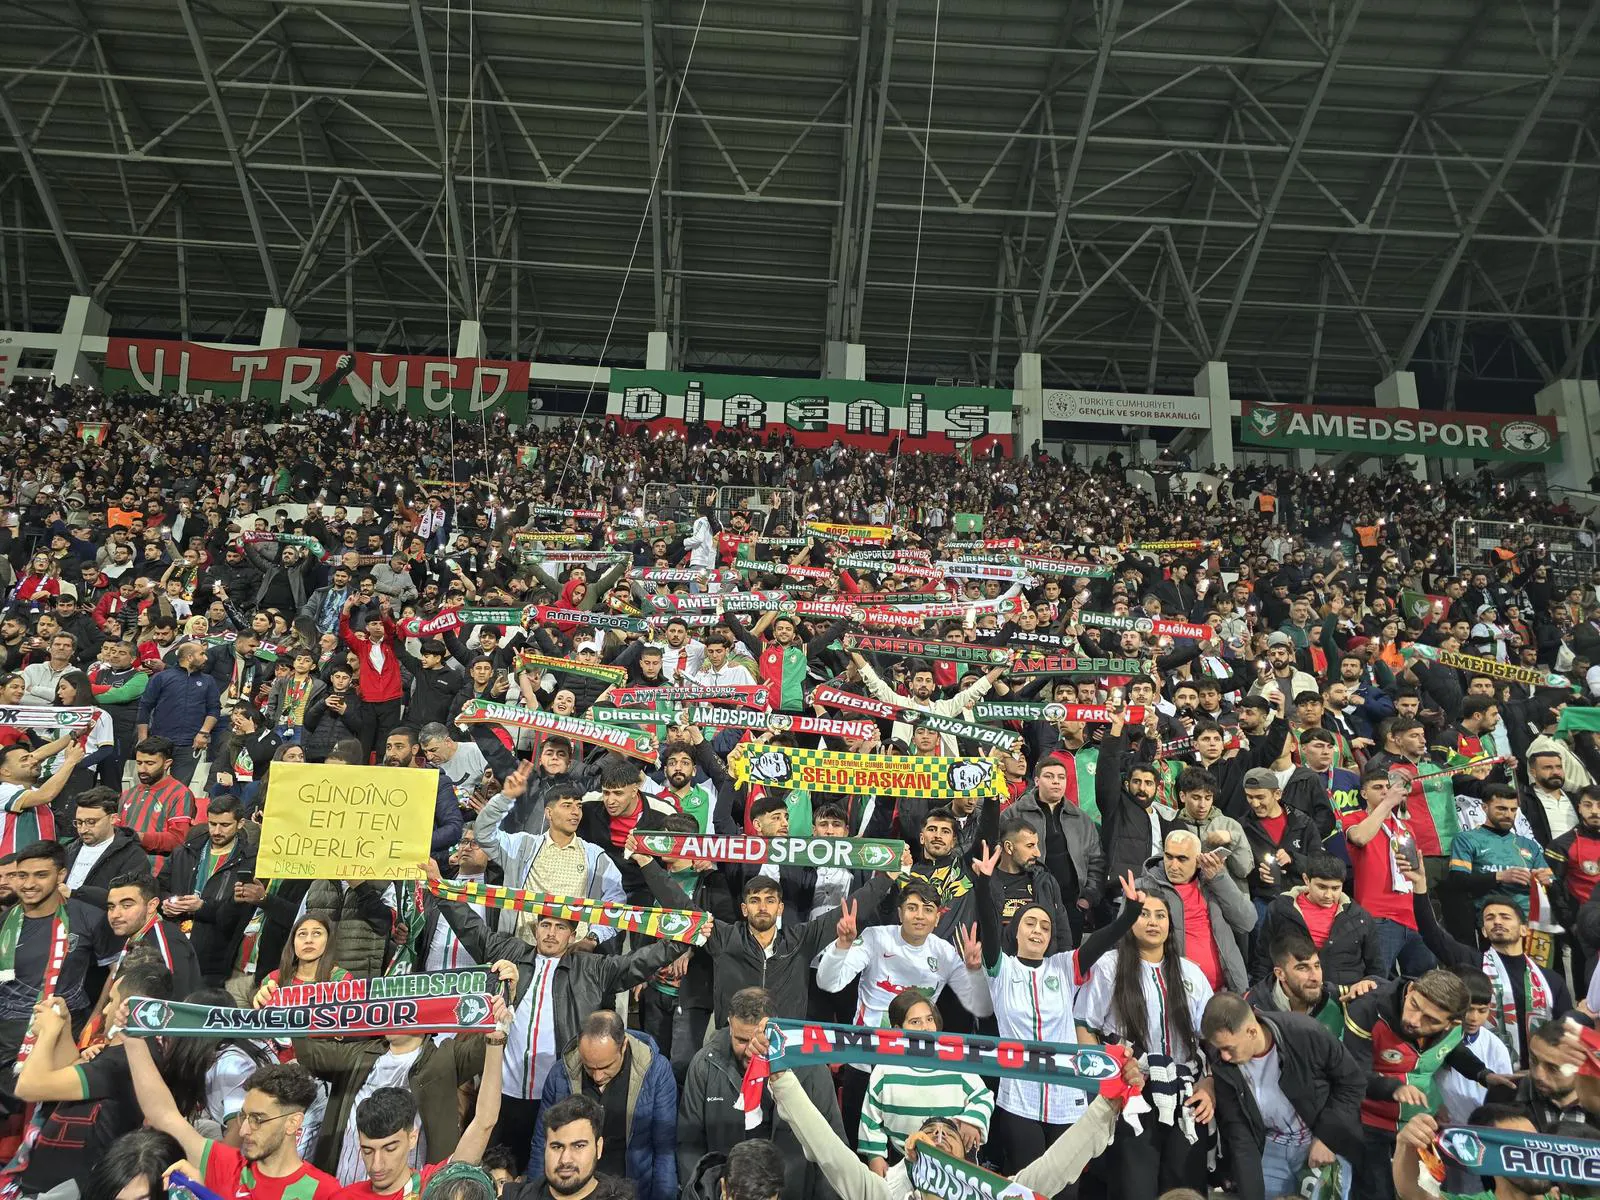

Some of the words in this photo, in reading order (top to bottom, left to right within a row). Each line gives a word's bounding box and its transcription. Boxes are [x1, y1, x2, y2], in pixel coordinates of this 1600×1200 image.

[1079, 396, 1115, 407] TÜRKİYE
[1116, 398, 1175, 410] CUMHURİYETİ
[1079, 407, 1115, 418] GENÇLİK
[1129, 410, 1152, 419] SPOR
[1154, 411, 1200, 420] BAKANLIĞI
[1286, 413, 1489, 448] AMEDSPOR
[645, 571, 717, 582] AMEDSPR
[737, 559, 774, 573] DİRENİŞ
[1025, 559, 1090, 575] AMEDSPOR
[727, 600, 778, 611] AMEDSPOR
[422, 614, 457, 633] AMED
[472, 610, 511, 623] SPOR
[546, 610, 630, 629] AMEDSPOR
[1082, 612, 1135, 630] DİRENİŞ
[859, 637, 988, 662] AMEDSPOR
[1441, 651, 1541, 684] AMEDSPOR
[599, 708, 671, 725] DİRENİŞ
[819, 690, 893, 717] DİRENİŞ
[927, 716, 1015, 750] NUSAYBİN
[977, 703, 1041, 719] DİRENİŞ
[485, 704, 554, 729] ŞAMPİYON
[558, 717, 629, 747] AMEDSPOR
[693, 707, 766, 727] AMEDSPOR
[801, 716, 875, 741] DİRENİŞ
[803, 767, 848, 786] SELO
[856, 770, 931, 791] BAŞKAN
[309, 810, 345, 829] EM
[356, 811, 400, 832] TEN
[680, 836, 766, 861] AMED
[769, 838, 853, 866] SPOR
[335, 864, 377, 877] ULTRA
[384, 866, 422, 879] AMED
[267, 980, 367, 1007] AMPIYON
[370, 972, 487, 1001] AMEDSPOR
[204, 1002, 419, 1030] AMEDSPOR
[801, 1024, 1060, 1073] AMEDSPOR
